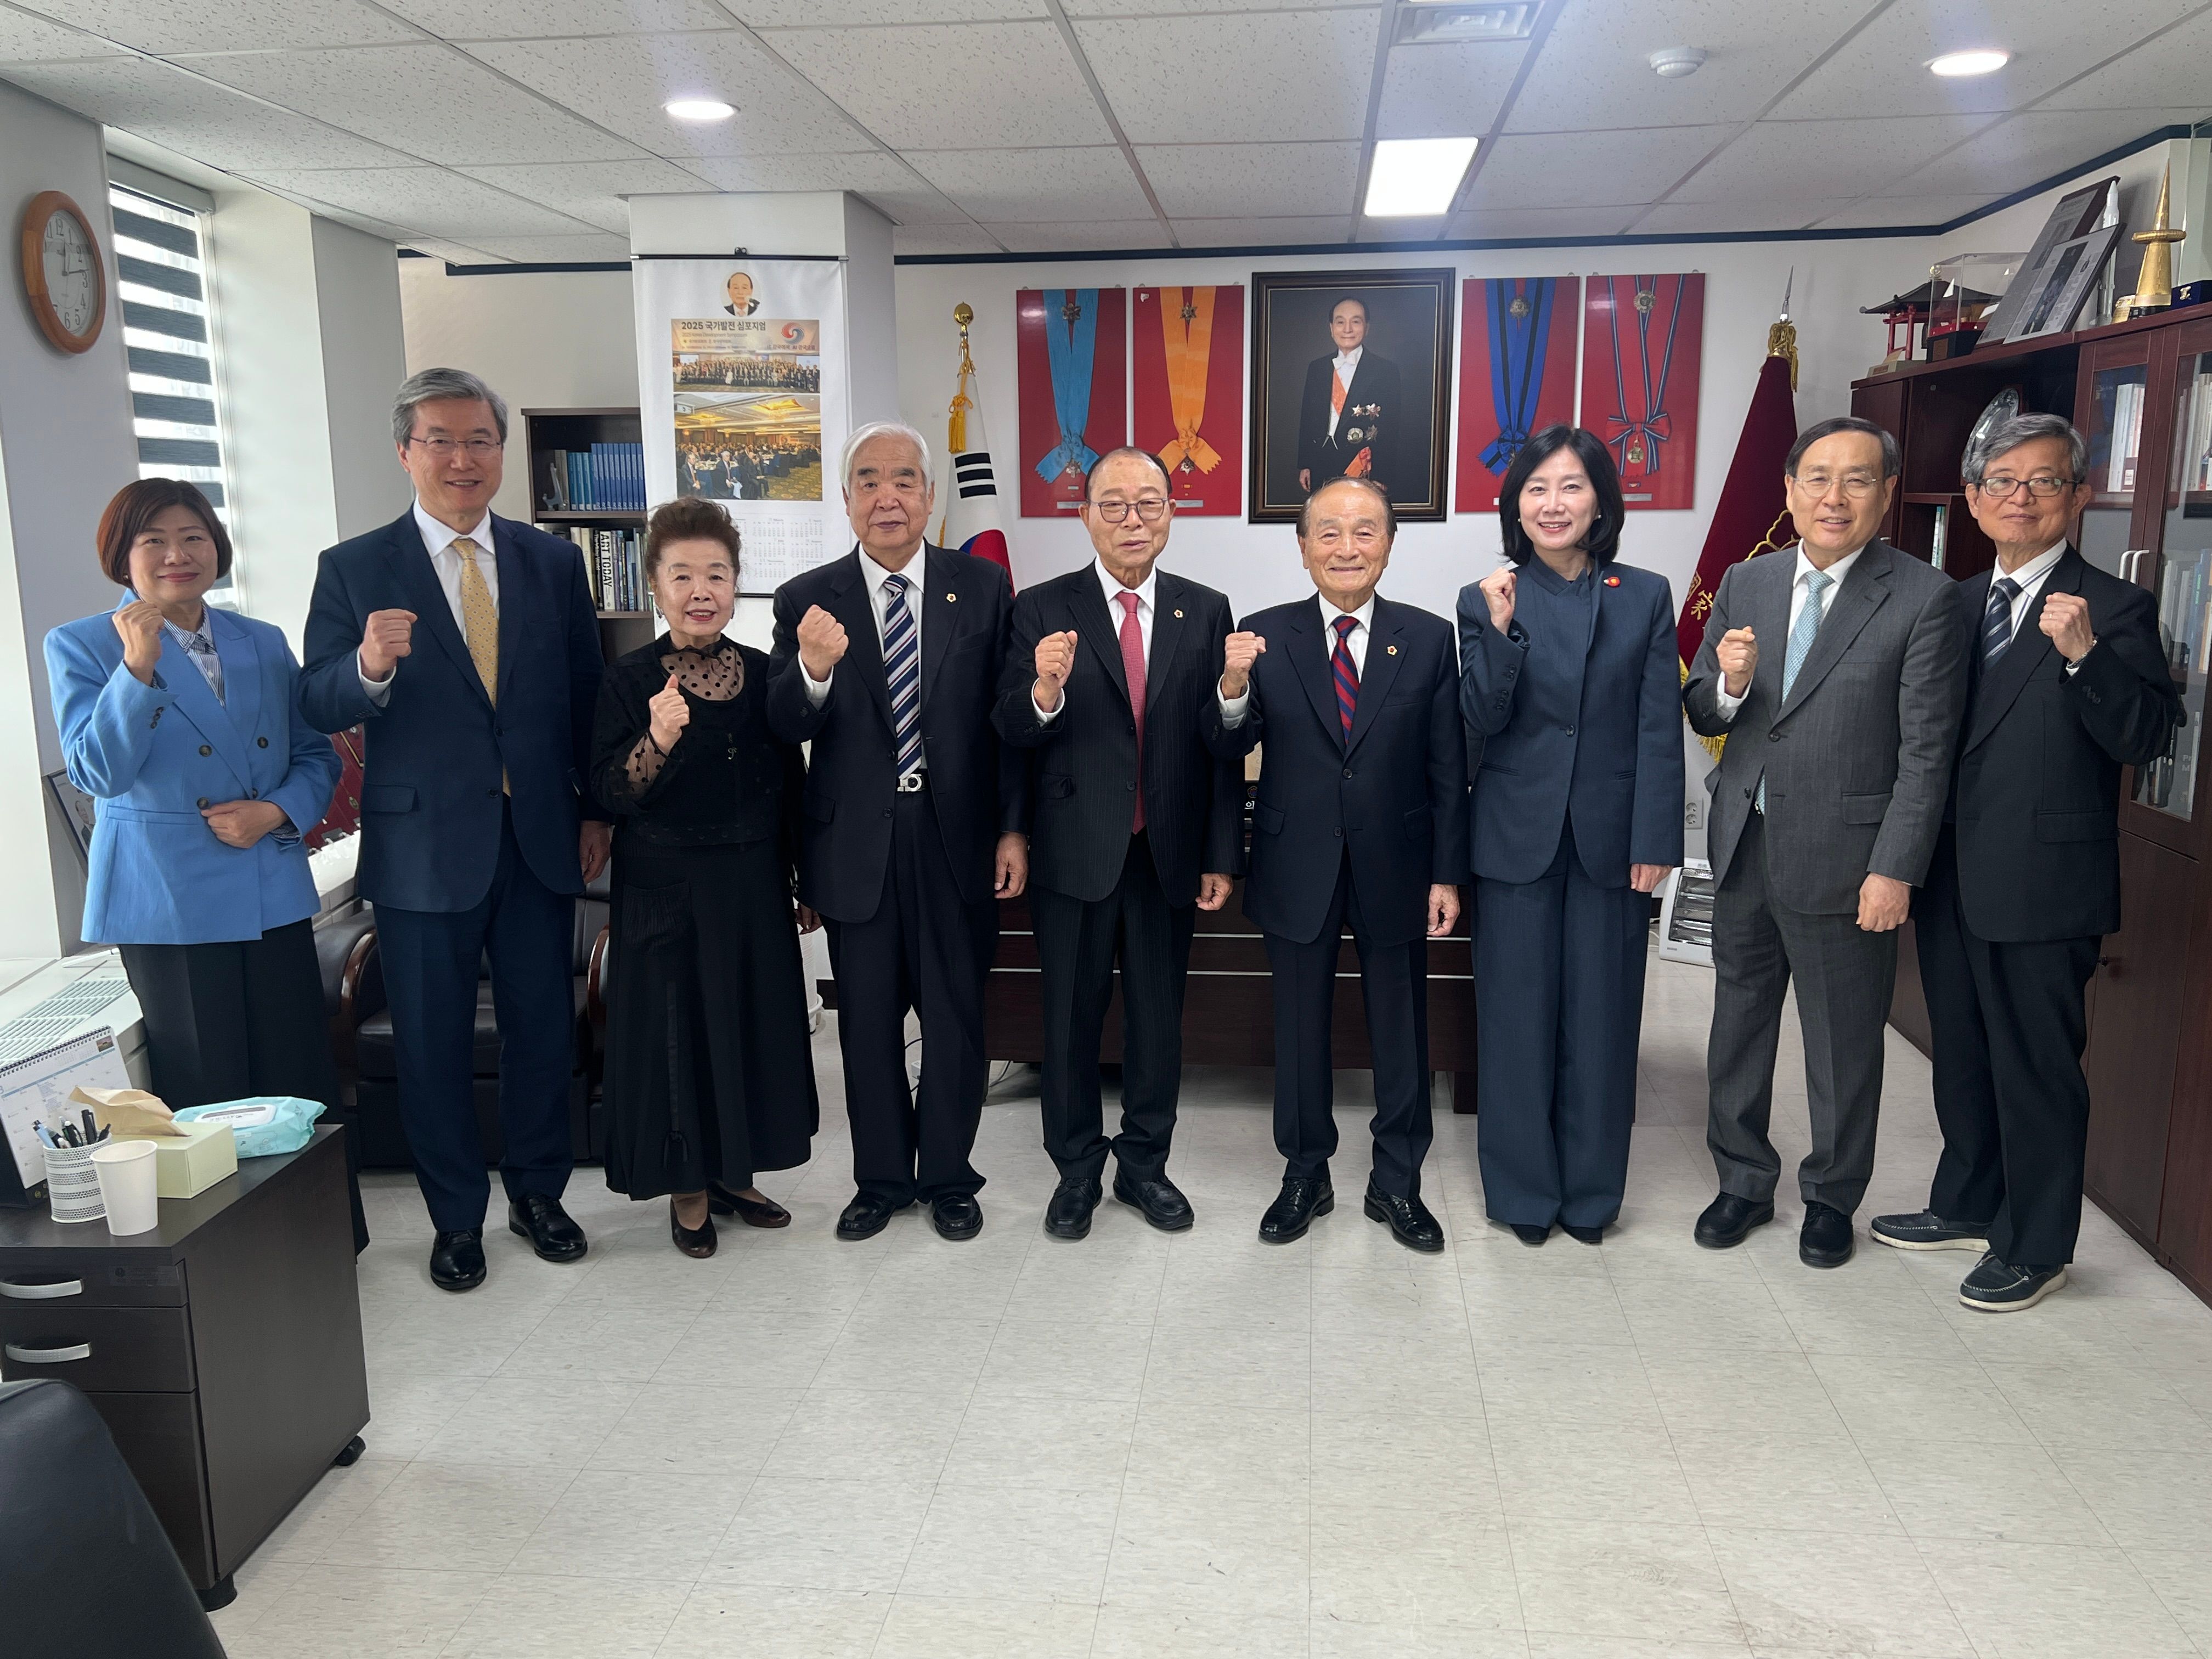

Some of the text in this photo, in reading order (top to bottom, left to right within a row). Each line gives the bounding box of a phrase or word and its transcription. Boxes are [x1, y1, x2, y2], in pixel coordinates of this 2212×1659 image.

[56, 218, 64, 236] 12
[76, 245, 82, 263] 2
[81, 294, 86, 310] 4
[65, 312, 70, 329] 6
[75, 309, 80, 325] 5
[681, 321, 766, 331] 2025 국가발전 심포지엄
[600, 534, 610, 554] ART
[602, 555, 612, 588] TODAY
